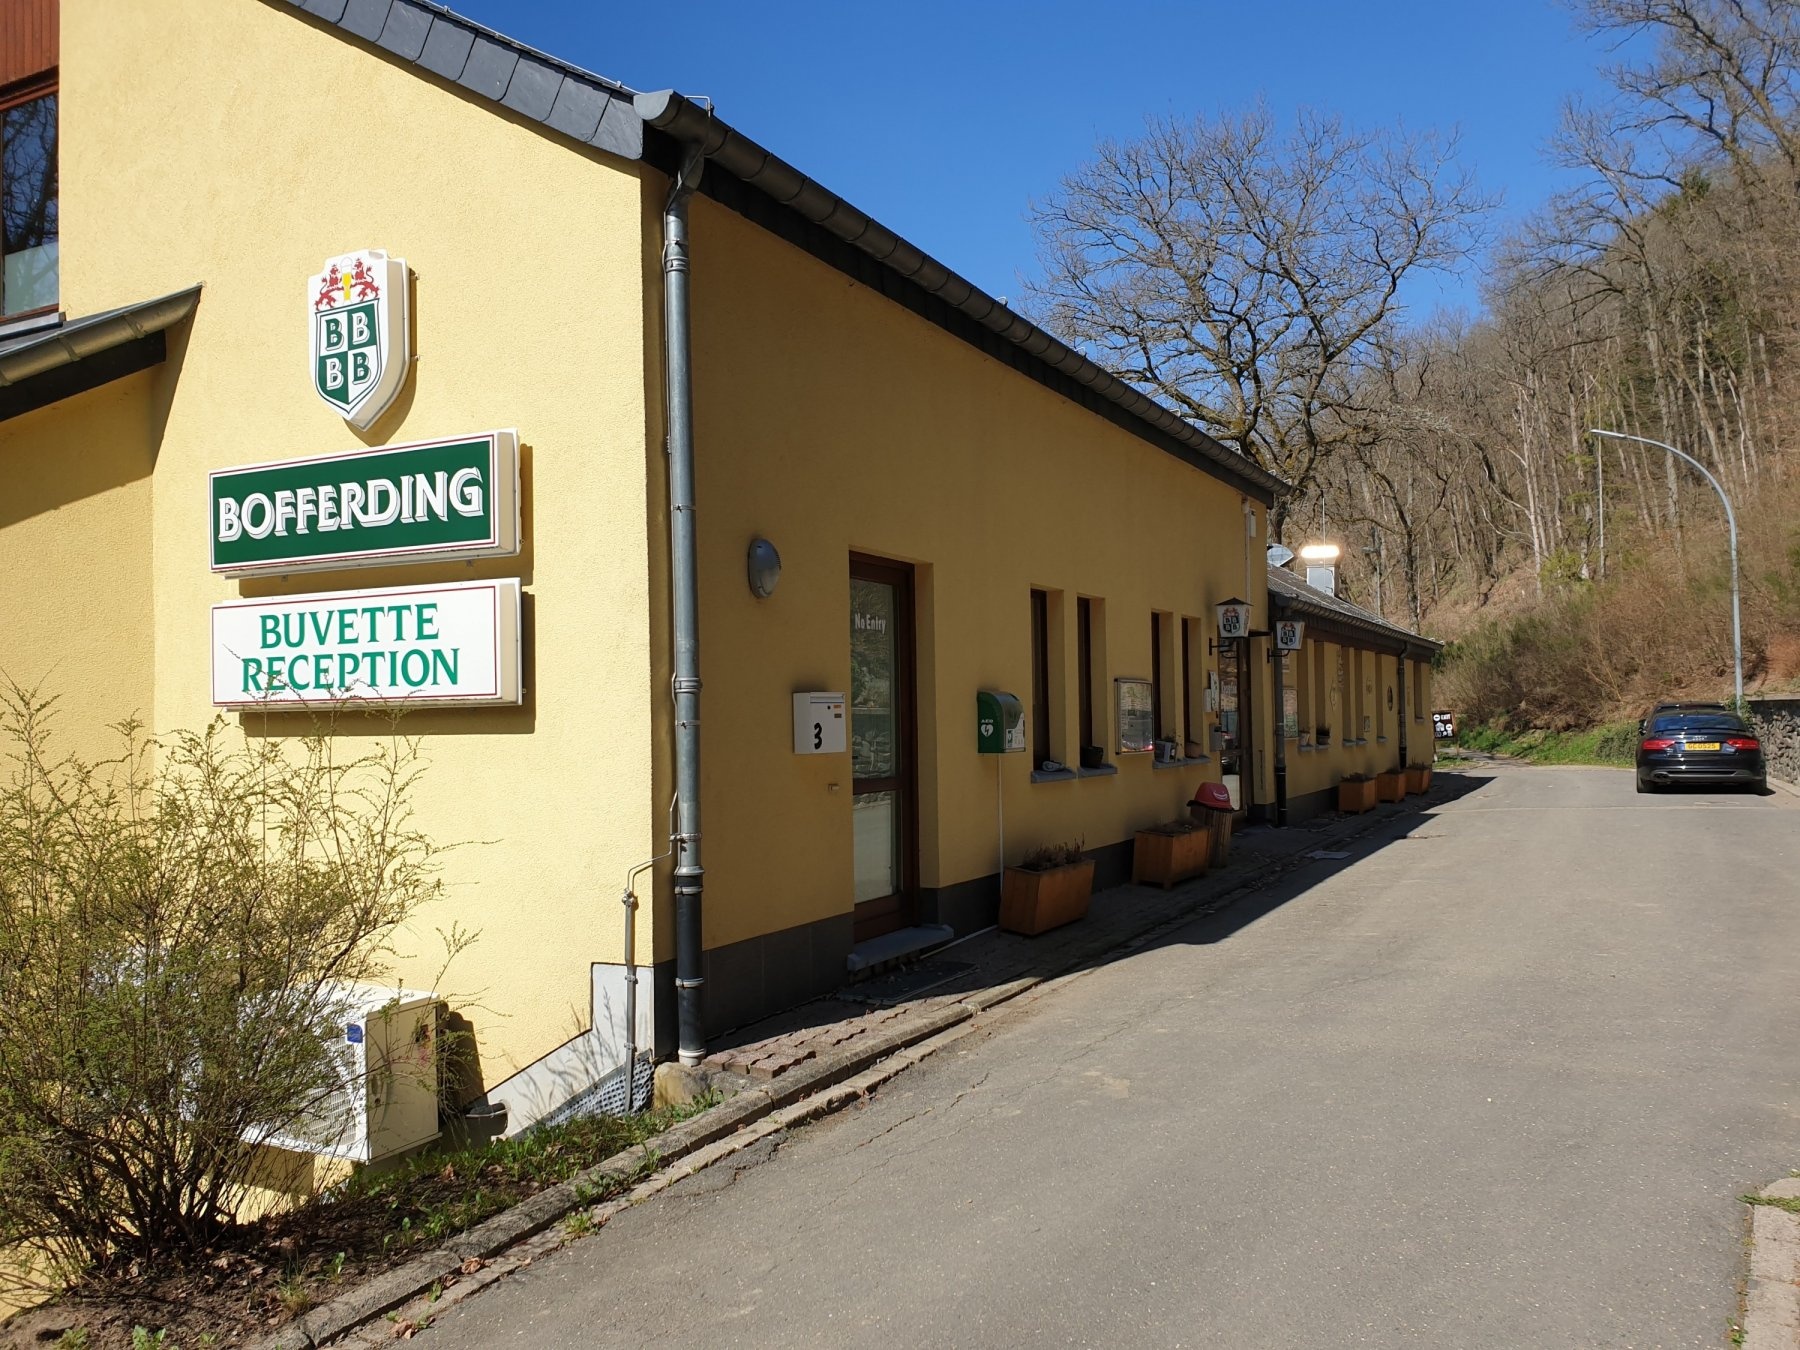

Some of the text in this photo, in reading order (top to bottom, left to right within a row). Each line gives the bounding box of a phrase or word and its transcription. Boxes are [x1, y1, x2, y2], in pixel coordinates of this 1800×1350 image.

[218, 467, 485, 542] BOFFERDING
[259, 603, 439, 648] BUVETTE
[854, 612, 886, 635] No Entry
[241, 647, 461, 693] RECEPTION
[814, 722, 822, 750] 3
